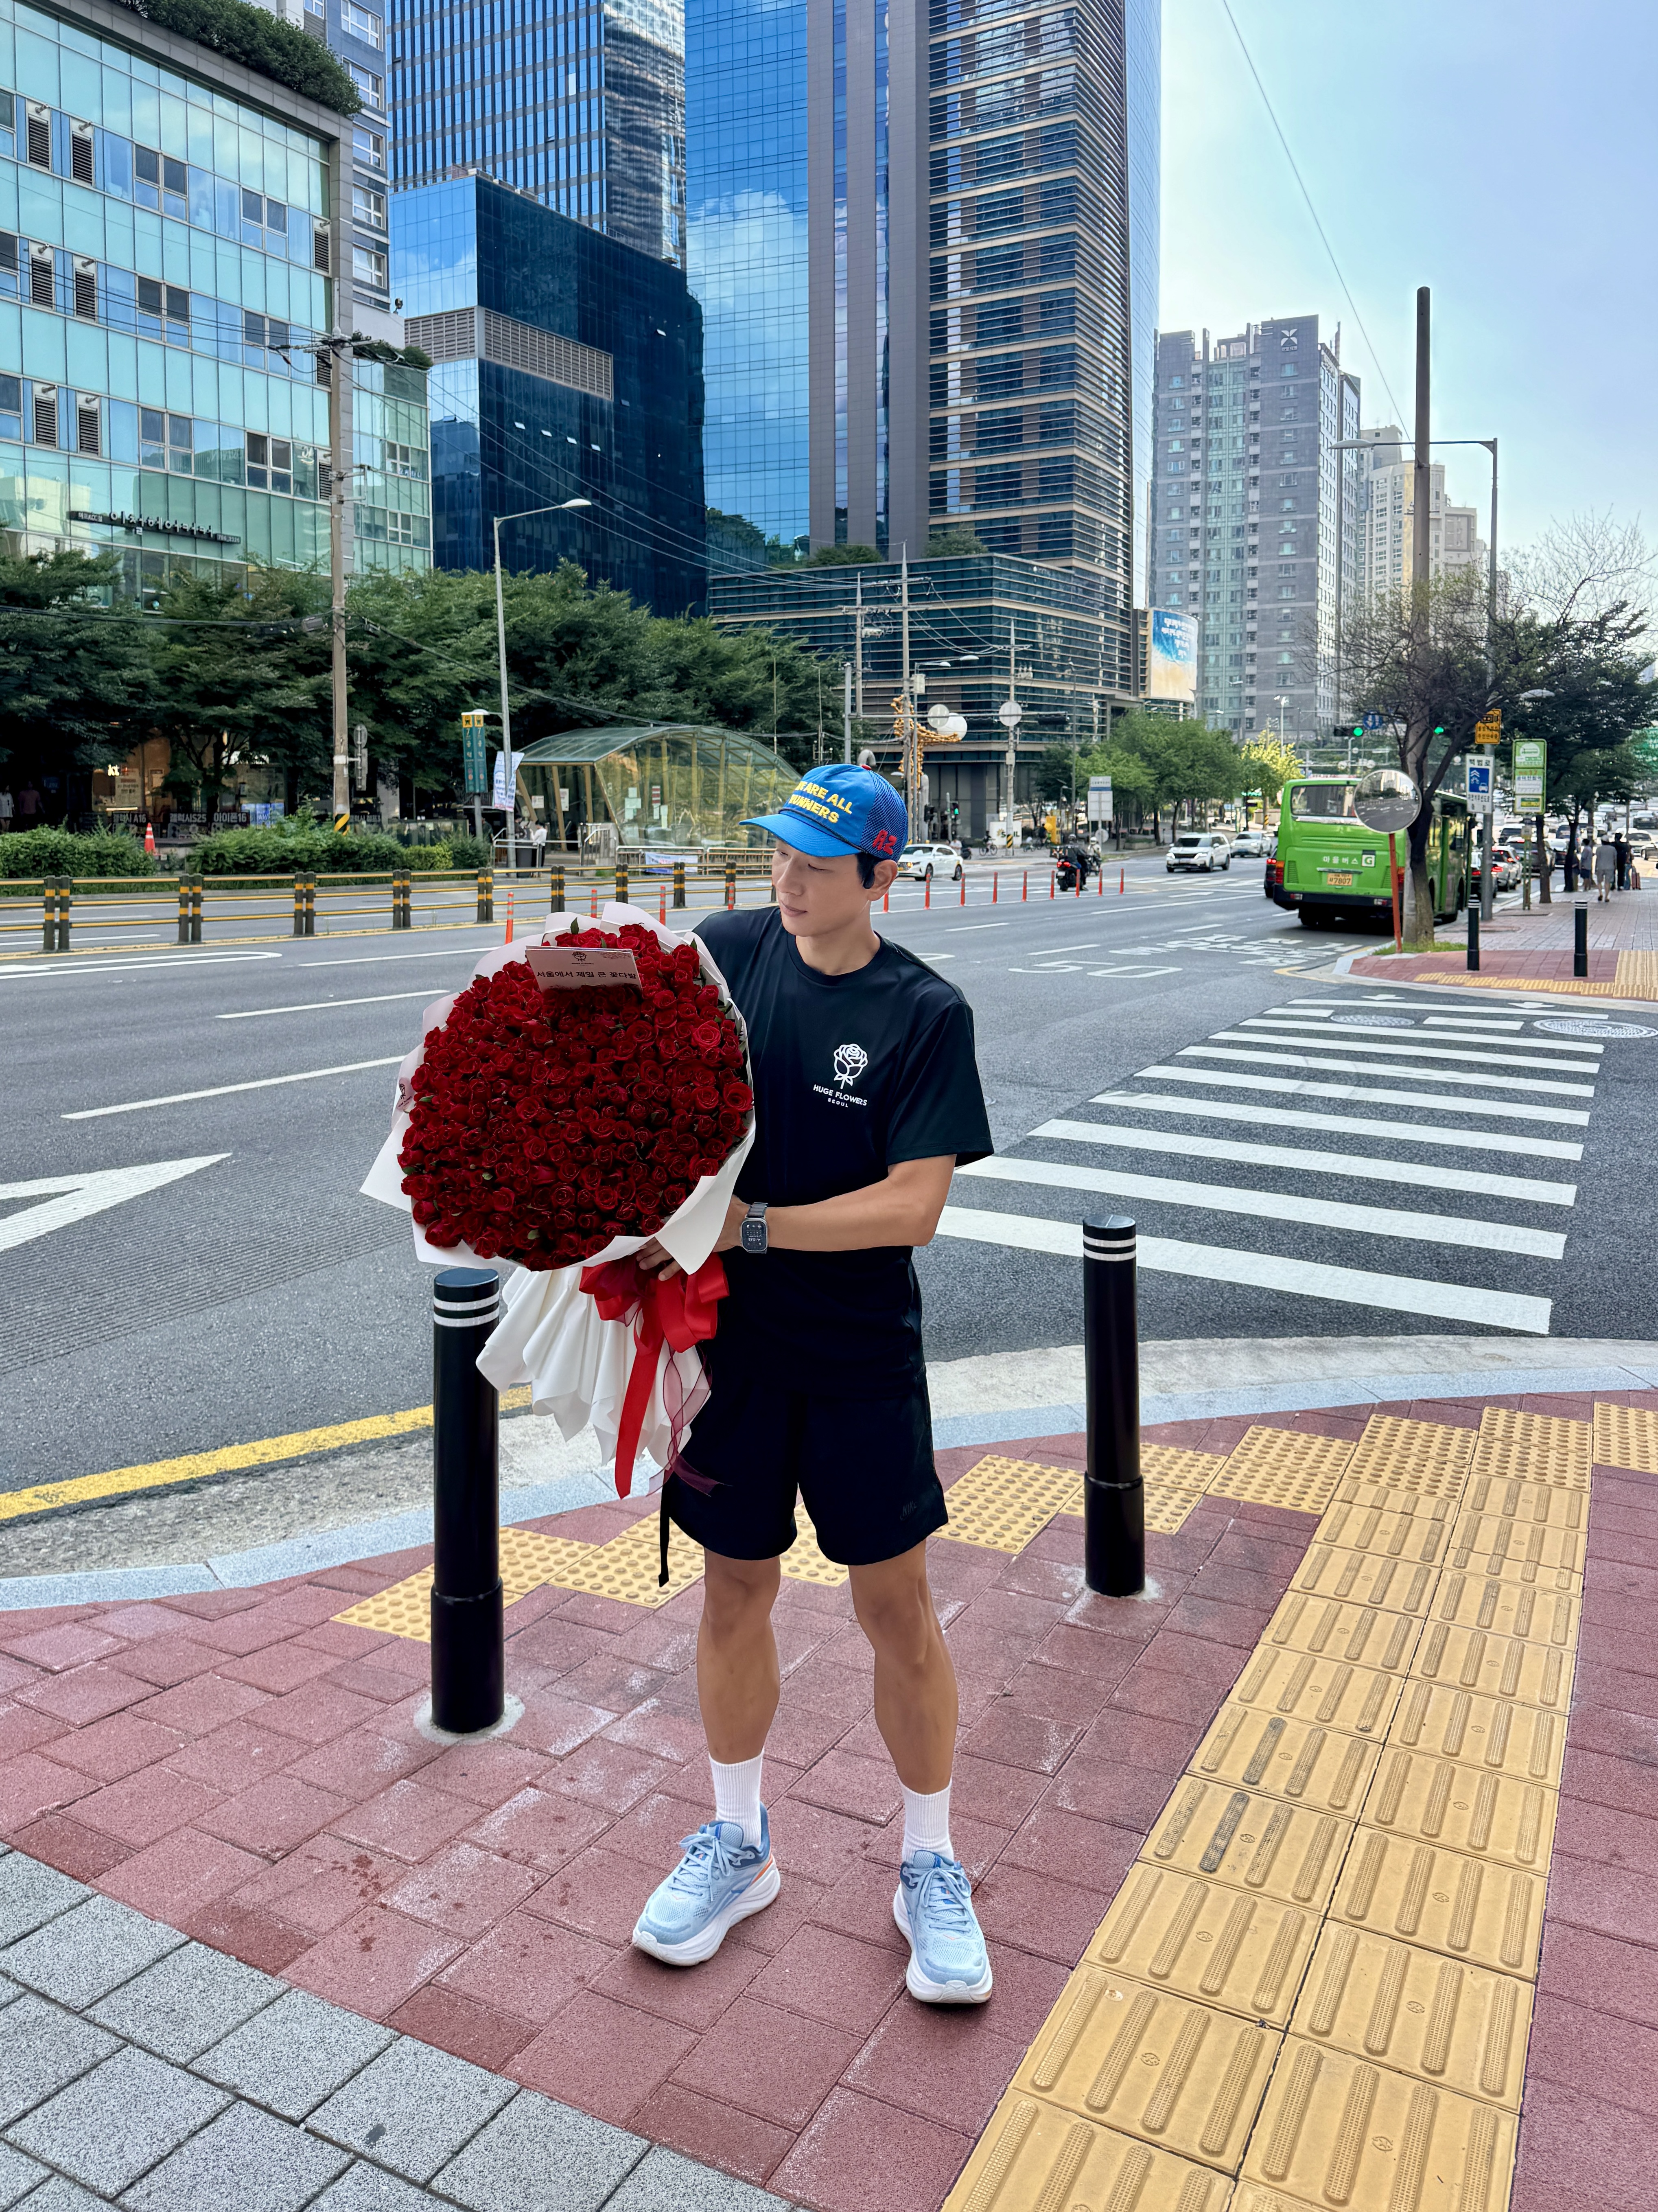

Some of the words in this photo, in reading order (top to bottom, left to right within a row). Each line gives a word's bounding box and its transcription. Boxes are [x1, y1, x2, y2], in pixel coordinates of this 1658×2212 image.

[1469, 758, 1491, 767] 백범로
[803, 782, 829, 800] ARE
[826, 793, 853, 815] ALL
[1323, 856, 1358, 865] 마을버스
[813, 1084, 834, 1096] HUGE
[835, 1091, 868, 1106] FLOWERS
[827, 1098, 849, 1108] SEOUL
